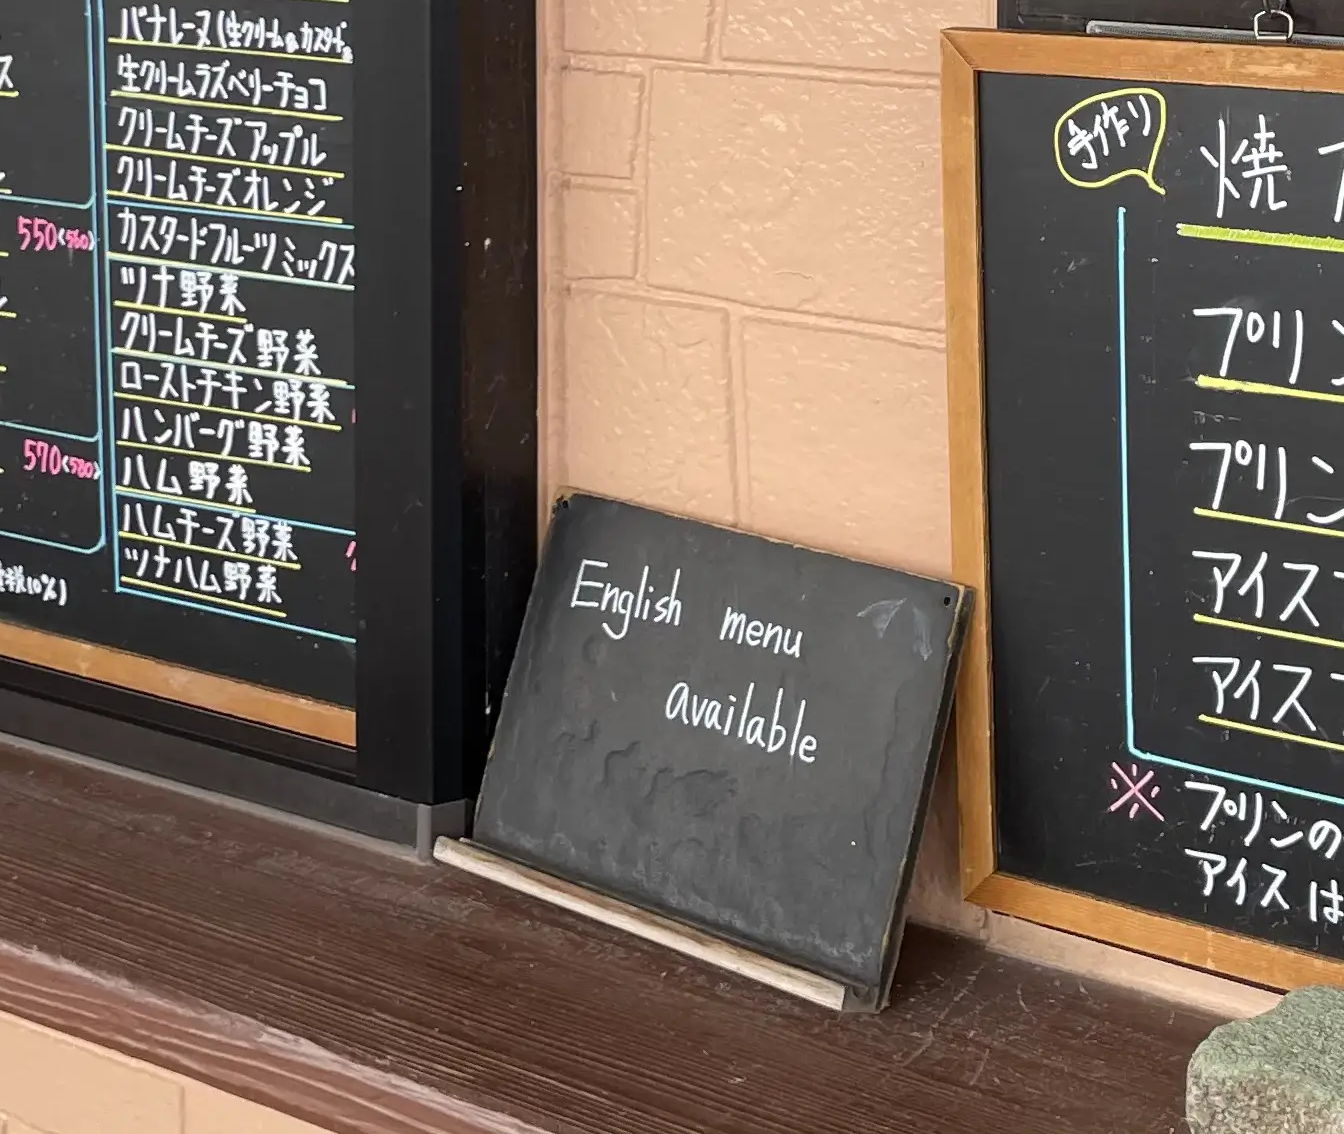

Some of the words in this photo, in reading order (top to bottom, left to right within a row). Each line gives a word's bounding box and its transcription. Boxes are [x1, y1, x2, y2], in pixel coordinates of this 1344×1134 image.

[118, 53, 326, 110] 生クリームラズベリーチョコ
[118, 107, 326, 166] クリームチーズアップル
[1066, 94, 1151, 170] 手作り
[118, 156, 334, 215] クリームチーズオレンジ
[117, 208, 354, 284] カスタードフルーツミックス
[121, 266, 246, 315] ツナ野菜
[121, 312, 321, 375] クリームチーズ野菜
[121, 362, 335, 423] ローストチキン野菜
[122, 406, 310, 467] ハンバーグ野菜
[123, 454, 253, 505] ハム野菜
[122, 503, 297, 561] ハムチーズ野菜
[125, 546, 282, 603] ツナハム野菜
[569, 558, 682, 640] English
[719, 605, 803, 658] menu
[665, 680, 818, 764] available
